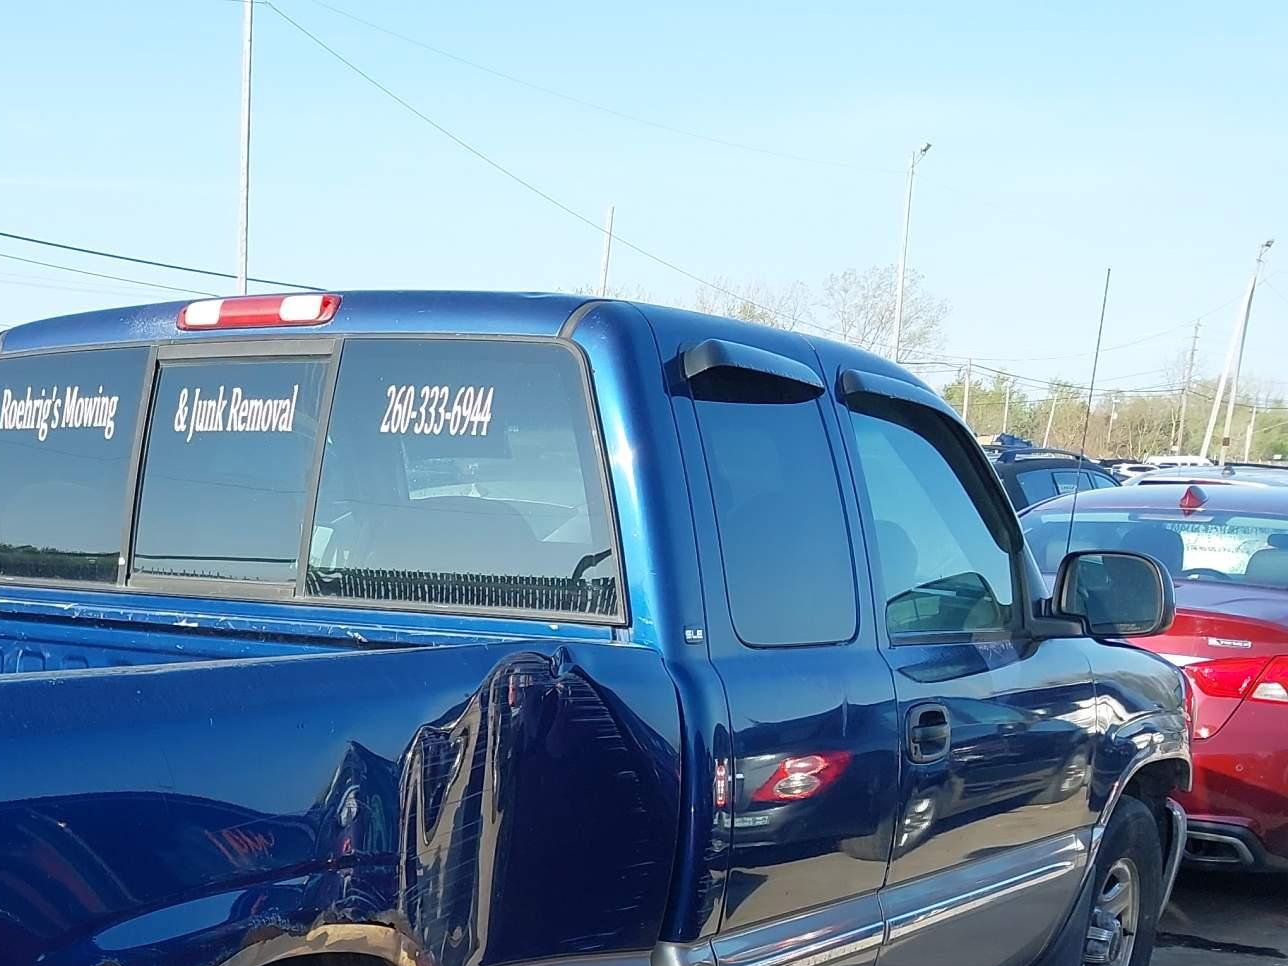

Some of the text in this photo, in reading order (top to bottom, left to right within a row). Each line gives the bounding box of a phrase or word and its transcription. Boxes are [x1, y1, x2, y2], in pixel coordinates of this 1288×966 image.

[61, 385, 119, 440] Mowing
[174, 384, 299, 443] & Junk Removal
[379, 384, 495, 436] 260-333-6944
